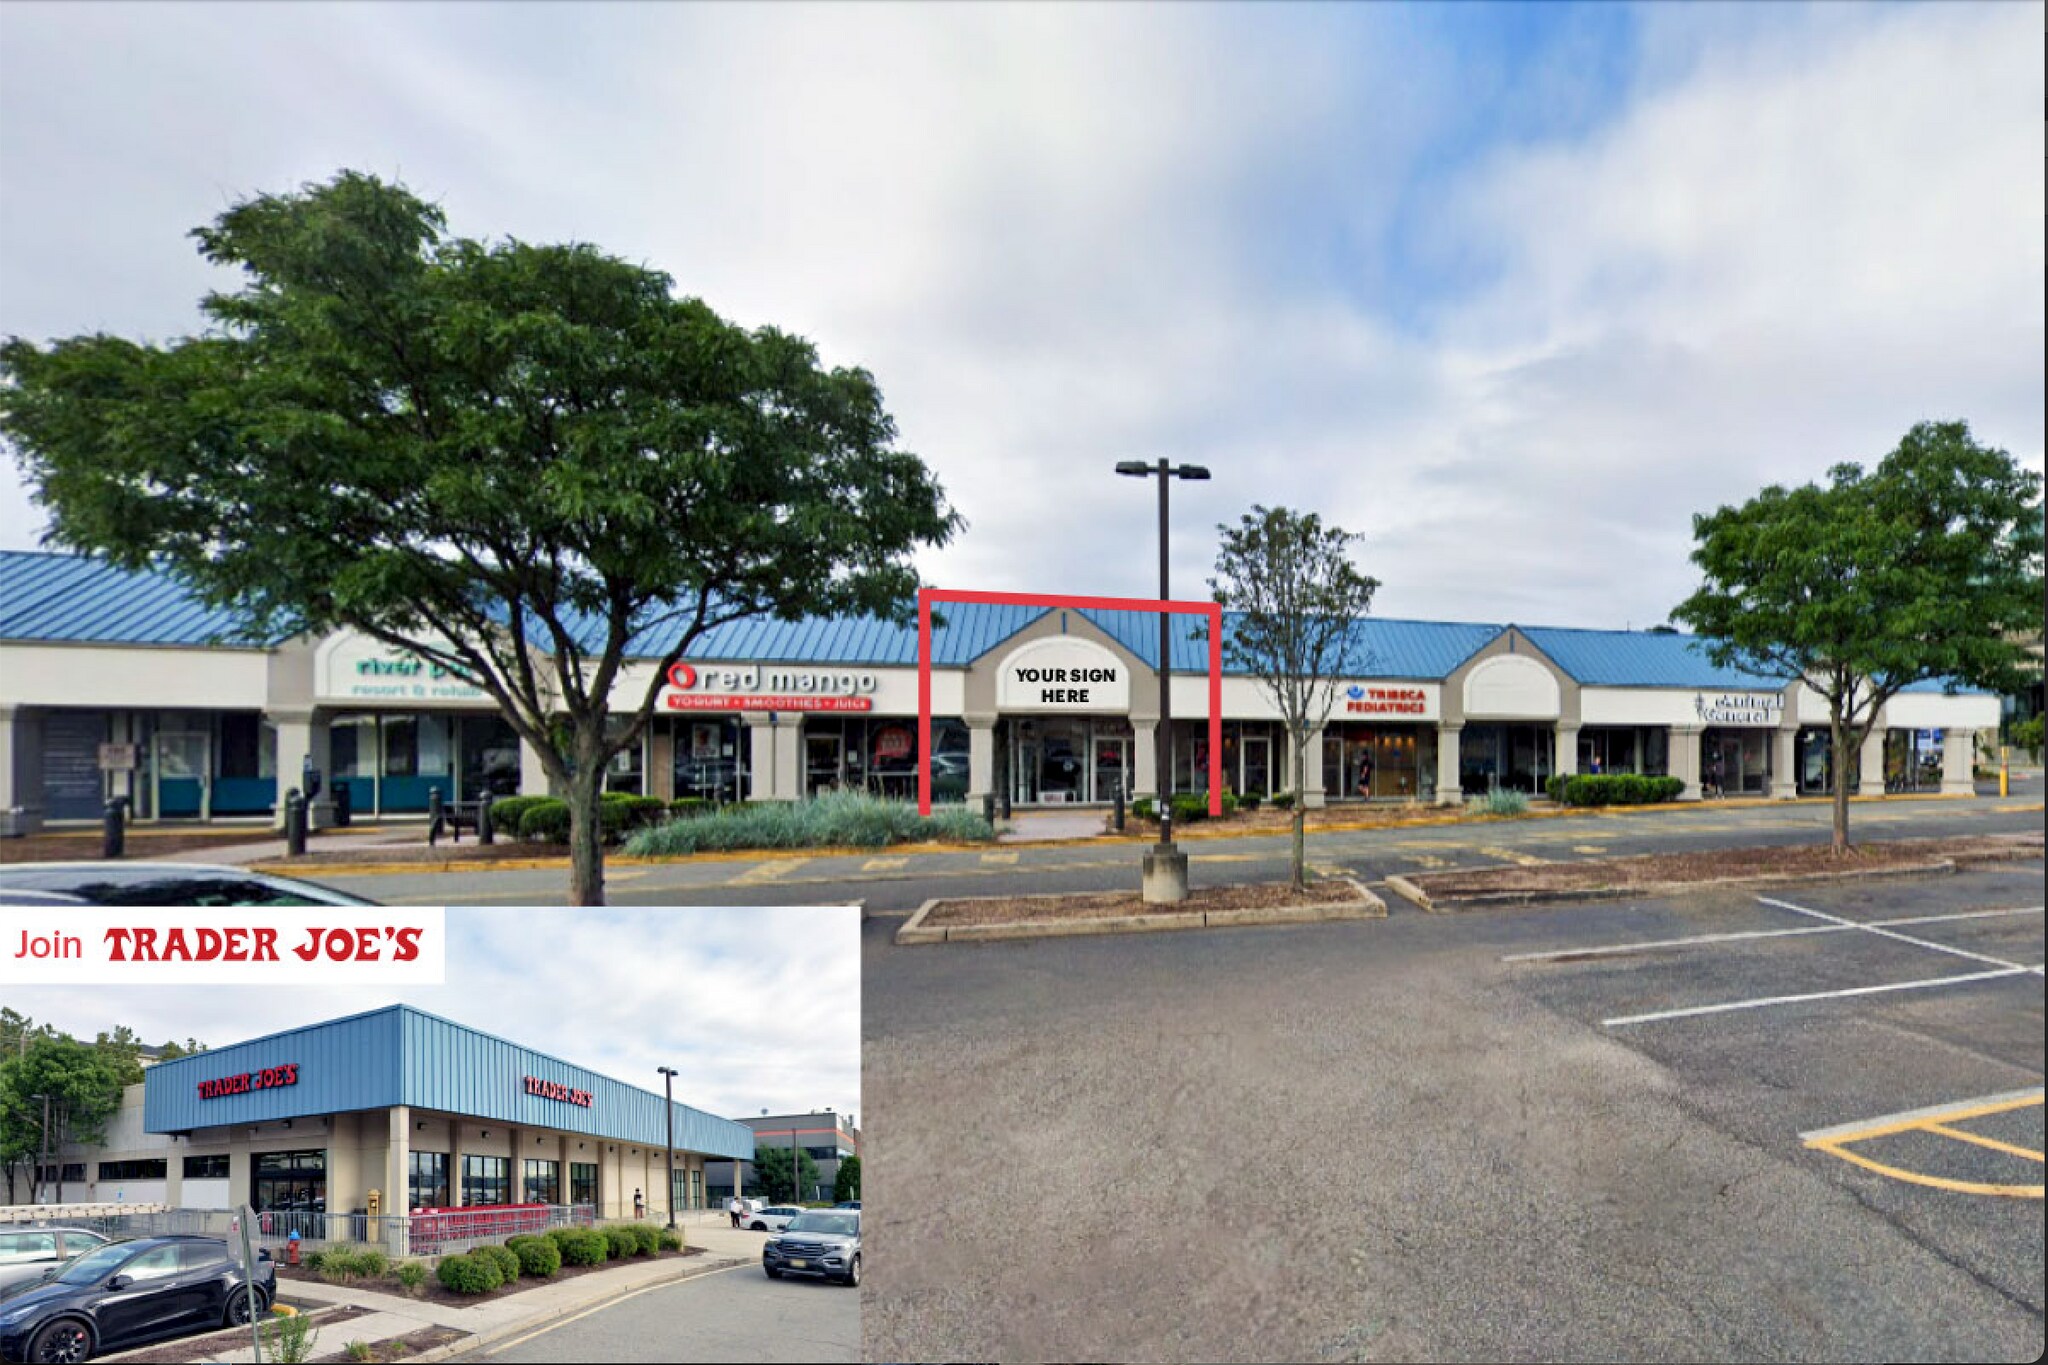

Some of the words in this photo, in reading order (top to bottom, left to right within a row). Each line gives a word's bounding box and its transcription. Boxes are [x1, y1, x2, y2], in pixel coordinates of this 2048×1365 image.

[702, 665, 760, 690] red
[768, 670, 876, 697] mango
[1368, 688, 1425, 700] TRIBECA
[1347, 701, 1425, 713] PEDIATRICS
[198, 1073, 251, 1100] TRADER
[254, 1062, 299, 1090] JOE'S
[524, 1075, 568, 1103] TRADER
